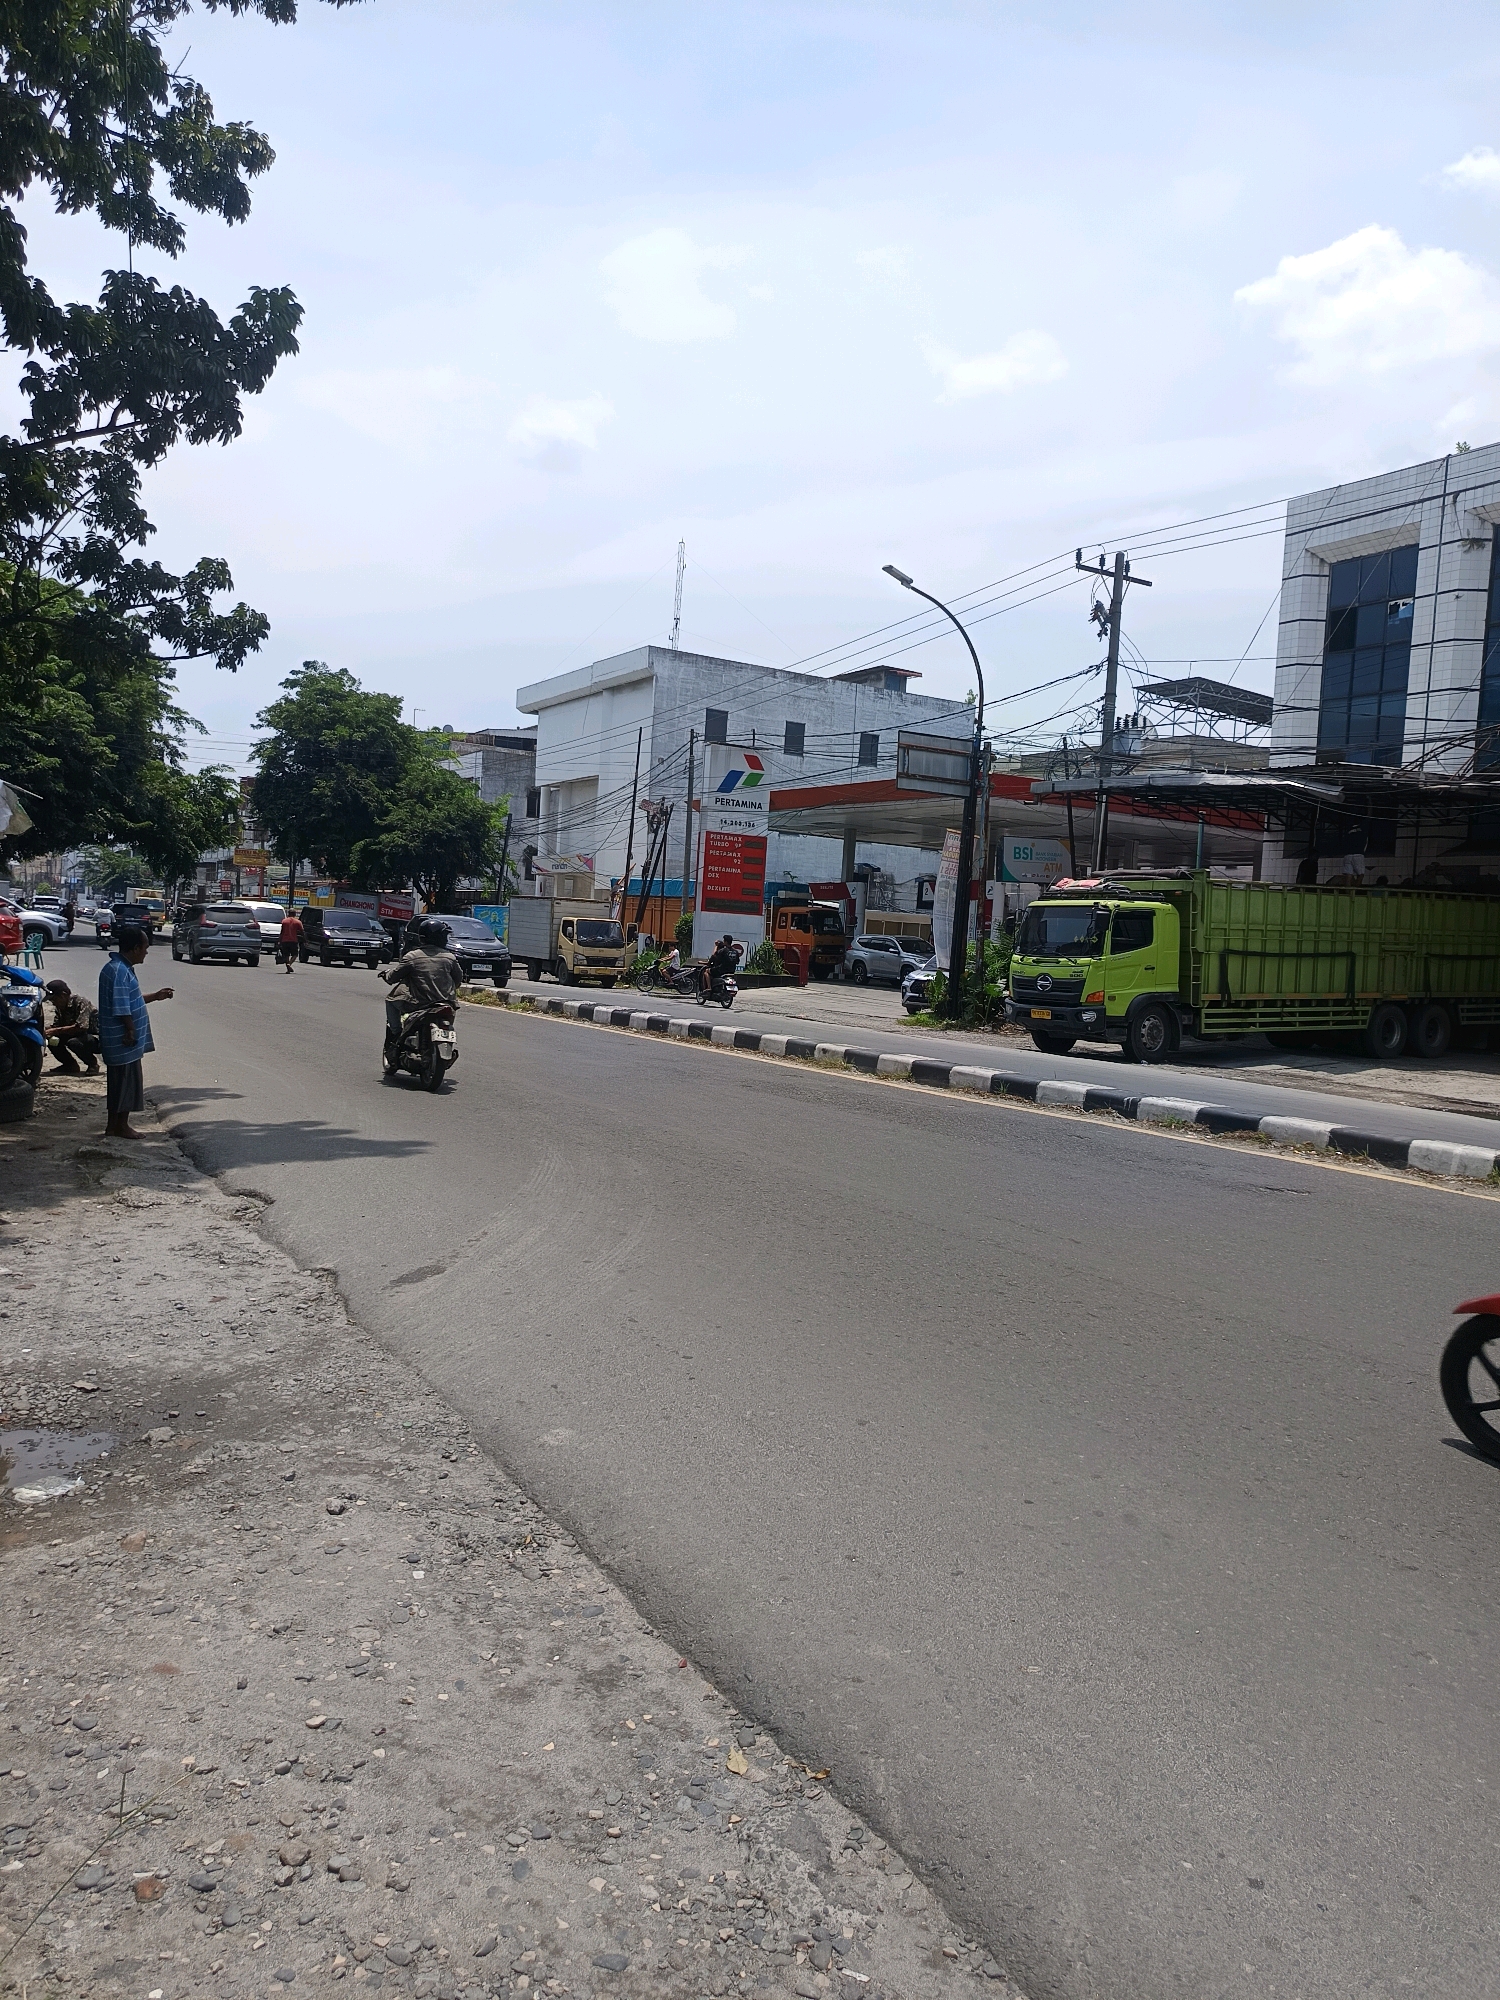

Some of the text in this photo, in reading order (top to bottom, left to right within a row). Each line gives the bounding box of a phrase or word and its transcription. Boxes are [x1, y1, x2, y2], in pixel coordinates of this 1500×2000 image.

[715, 797, 763, 810] PERTAMINA
[710, 833, 743, 842] PERTAMAX
[709, 849, 742, 858] PERTAMAX
[1013, 846, 1034, 861] BSI
[1044, 862, 1063, 873] ATM
[924, 887, 929, 896] 2
[339, 898, 375, 910] CHANGHONG
[384, 896, 412, 907] CHANGHONG
[380, 907, 394, 916] STM
